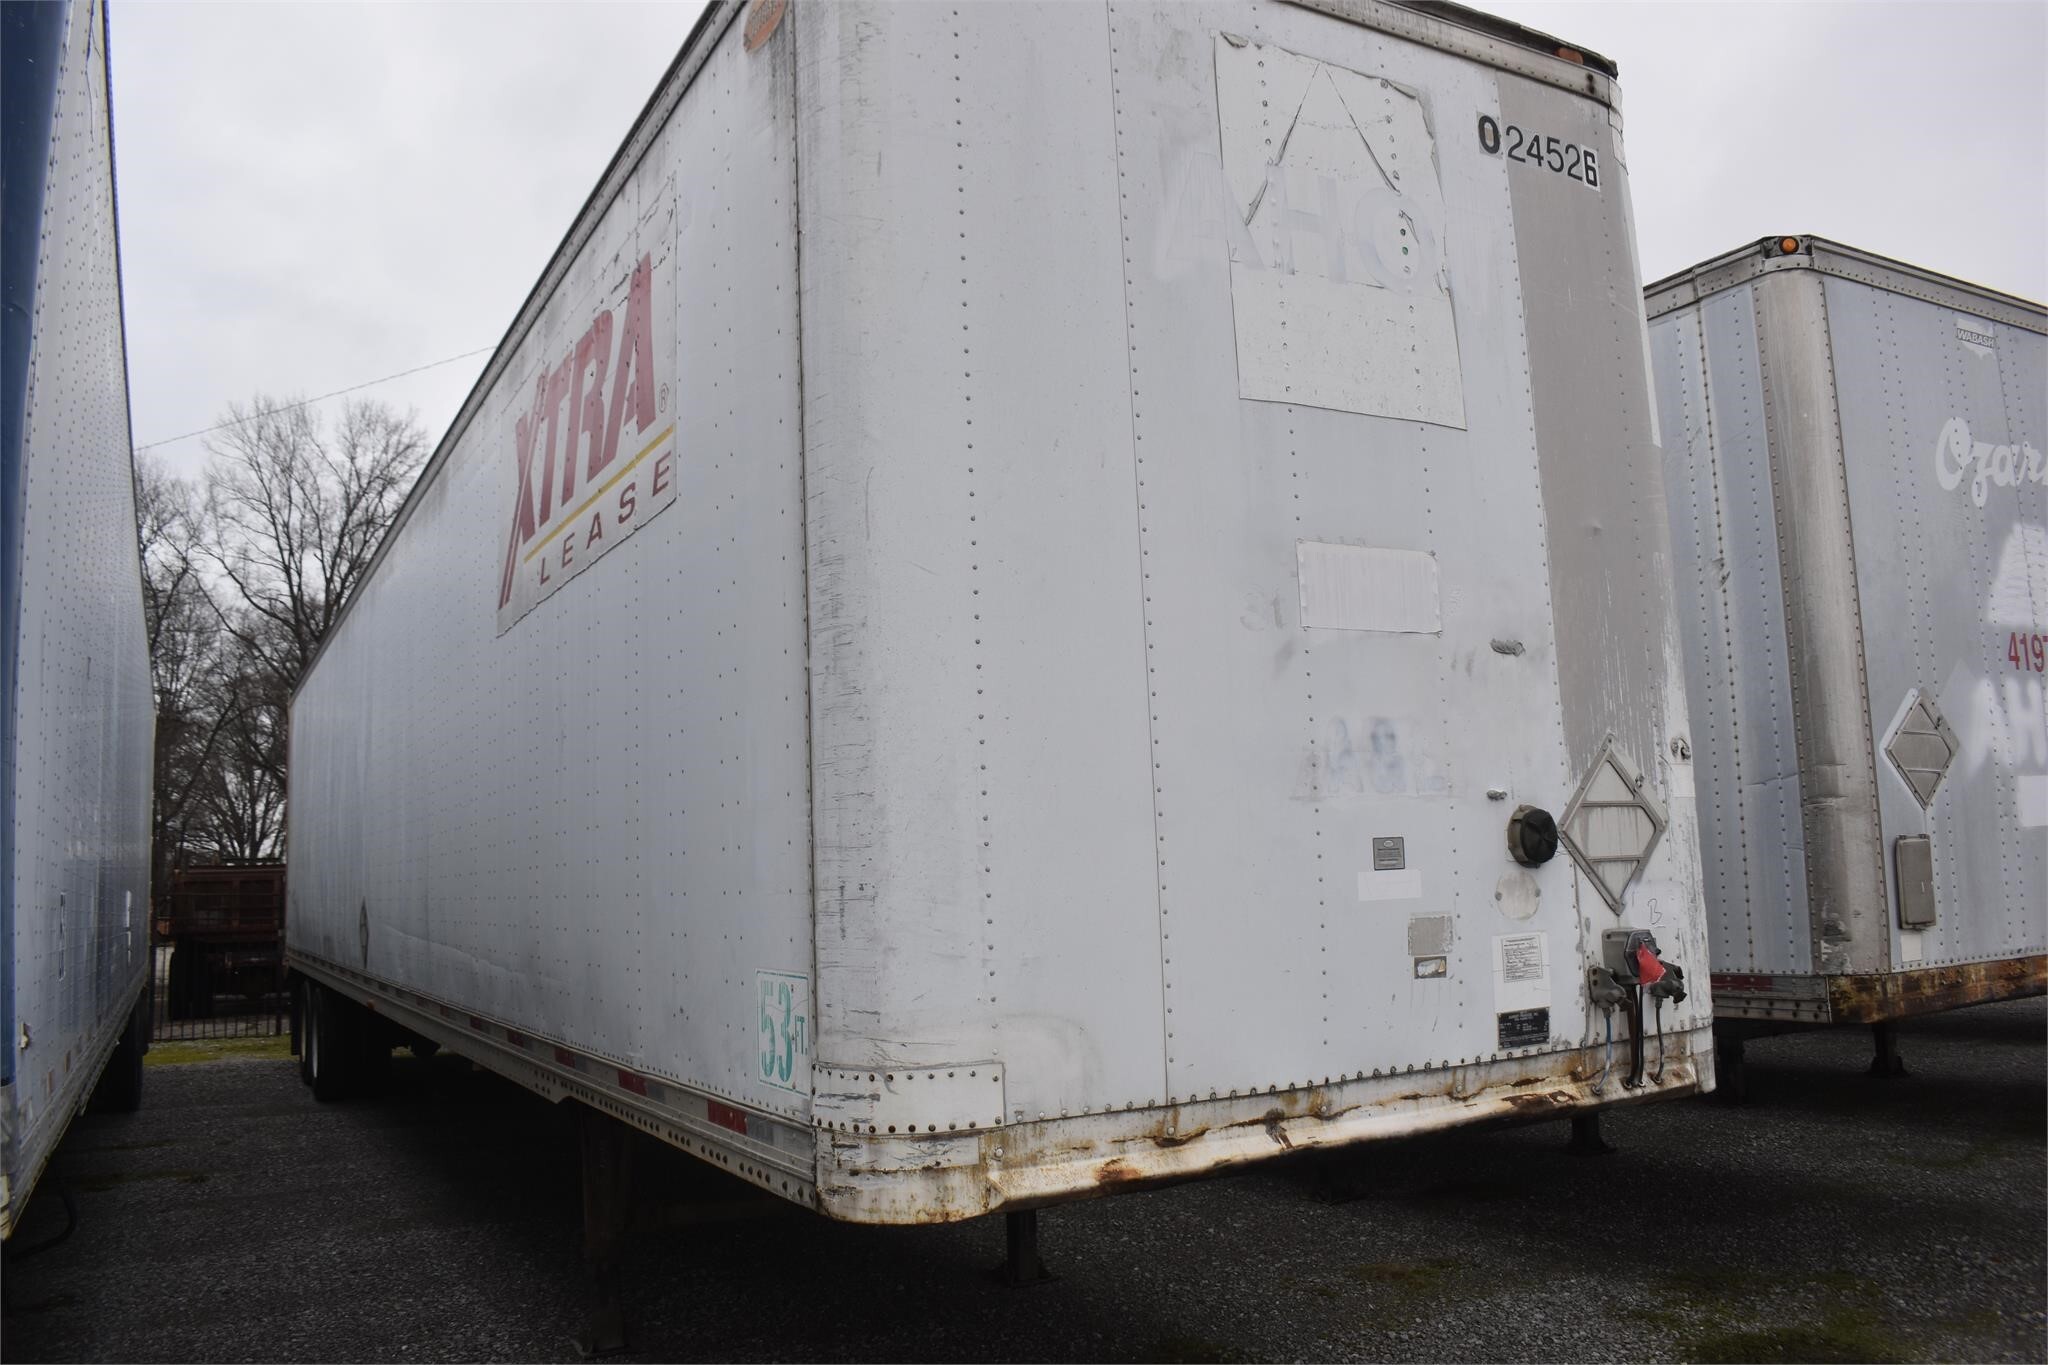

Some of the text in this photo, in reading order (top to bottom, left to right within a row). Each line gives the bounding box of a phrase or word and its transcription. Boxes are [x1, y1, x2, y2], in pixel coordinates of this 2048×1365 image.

[1478, 115, 1598, 187] 024526
[1957, 328, 1995, 348] WABASH
[499, 251, 656, 610] XTRA
[1936, 417, 2048, 508] Ozar
[541, 451, 672, 586] LEASE
[761, 980, 793, 1082] 53
